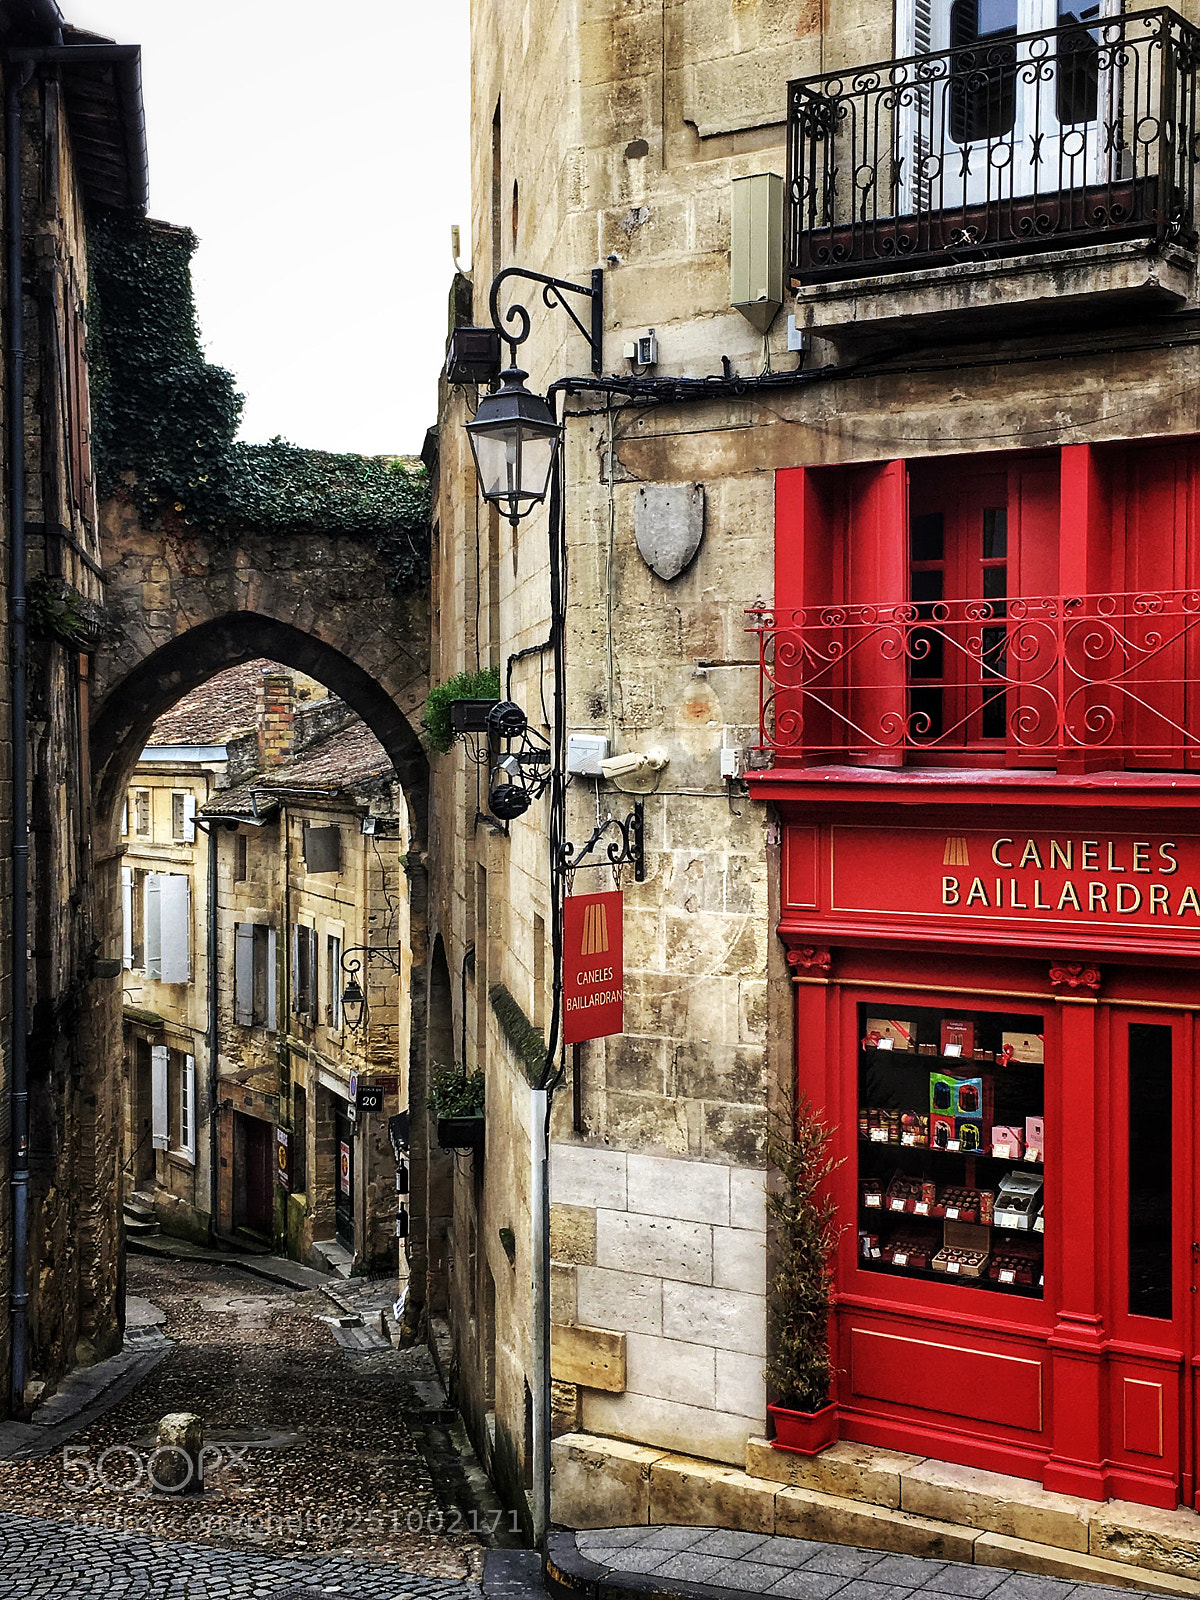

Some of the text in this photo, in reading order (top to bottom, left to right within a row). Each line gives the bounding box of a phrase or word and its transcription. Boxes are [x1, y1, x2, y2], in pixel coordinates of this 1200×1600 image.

[991, 837, 1178, 874] CANELES
[941, 876, 1200, 917] BAILLARDRA
[576, 967, 614, 986] CANELES
[566, 989, 623, 1012] BAILLARDRAN
[362, 1096, 377, 1107] 20
